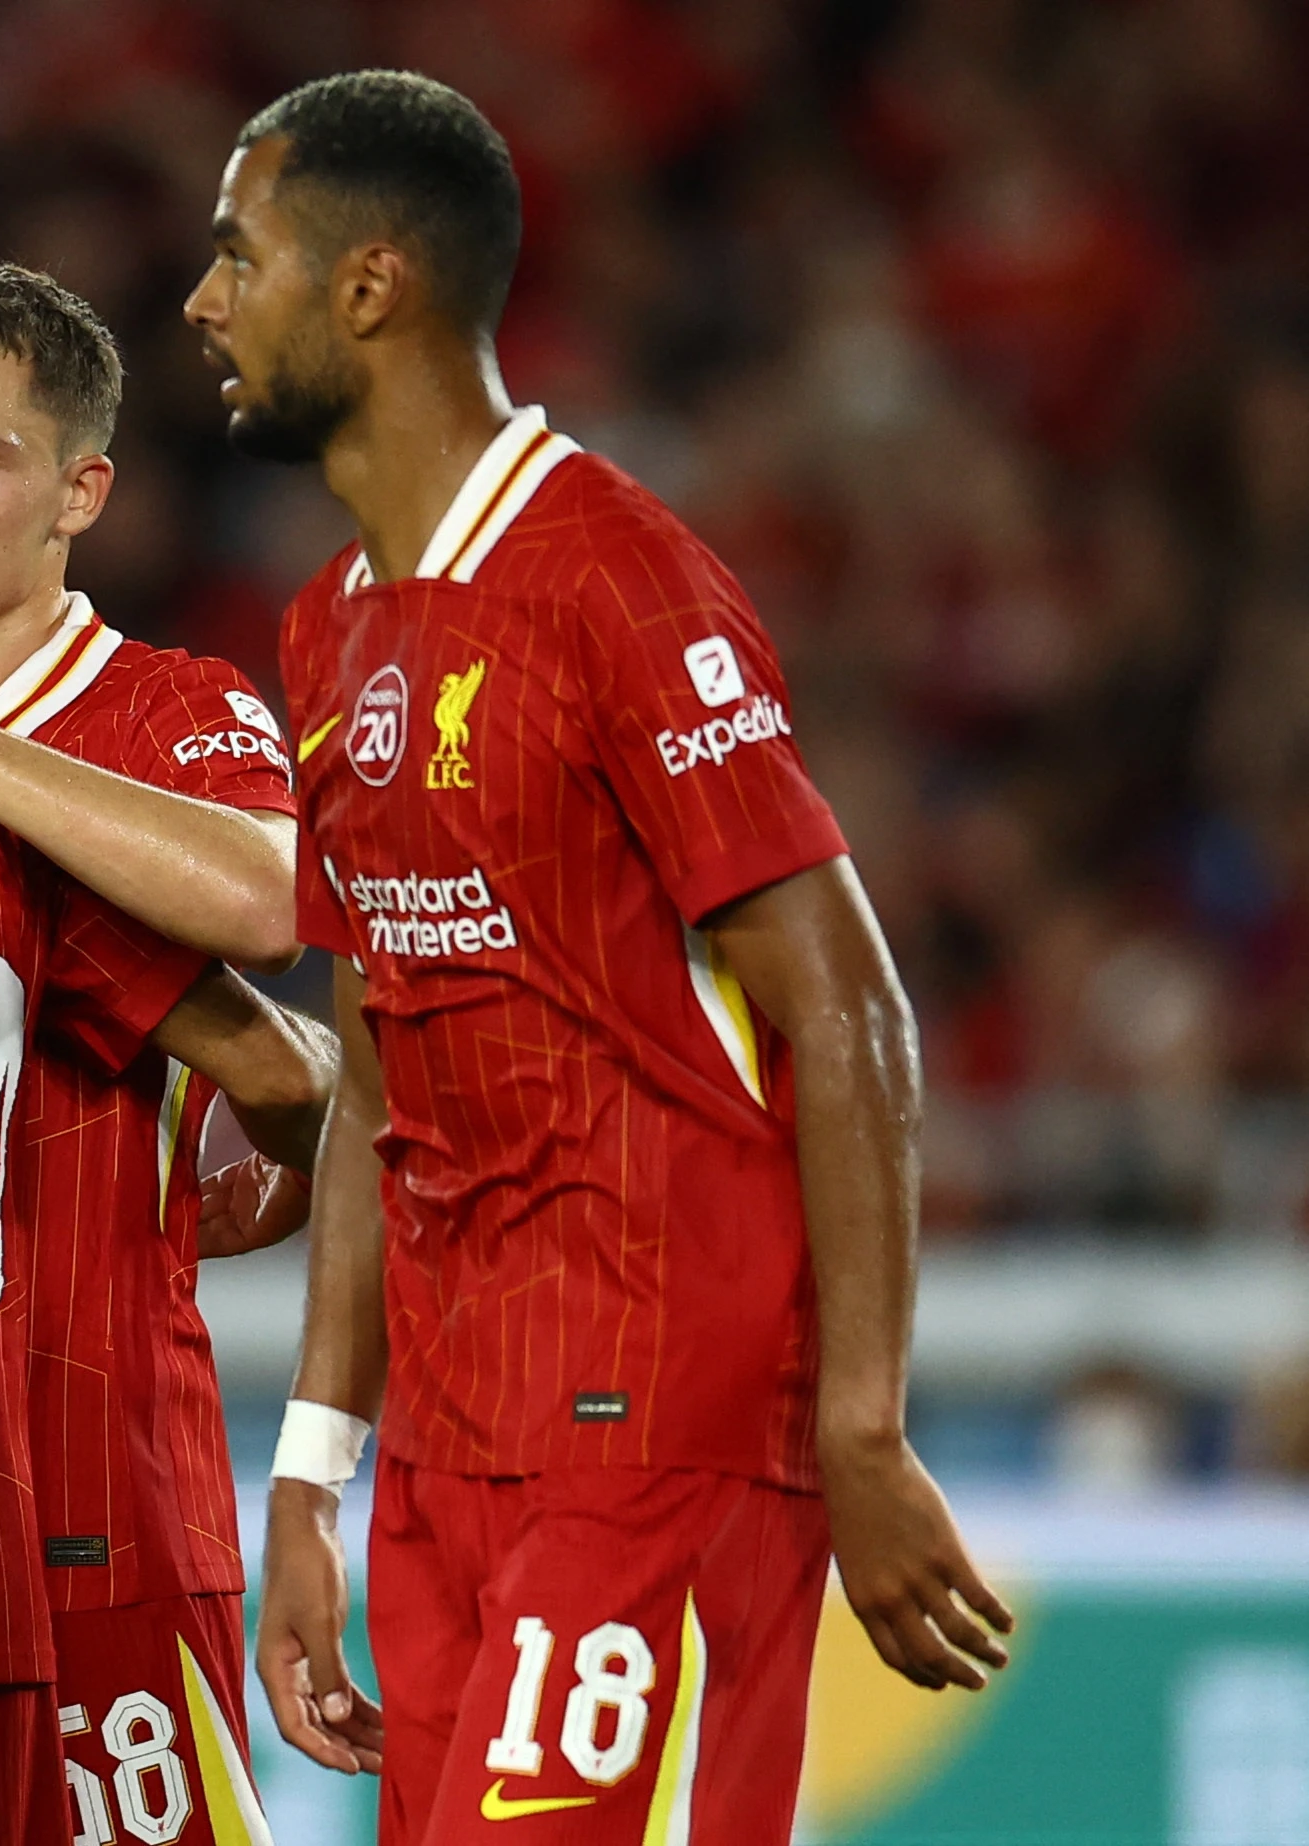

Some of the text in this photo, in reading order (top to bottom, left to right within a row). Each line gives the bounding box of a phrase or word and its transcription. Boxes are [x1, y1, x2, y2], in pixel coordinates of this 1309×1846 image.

[354, 710, 397, 762] 20
[427, 761, 475, 789] LFC
[367, 905, 517, 958] hartered
[485, 1616, 657, 1788] 18
